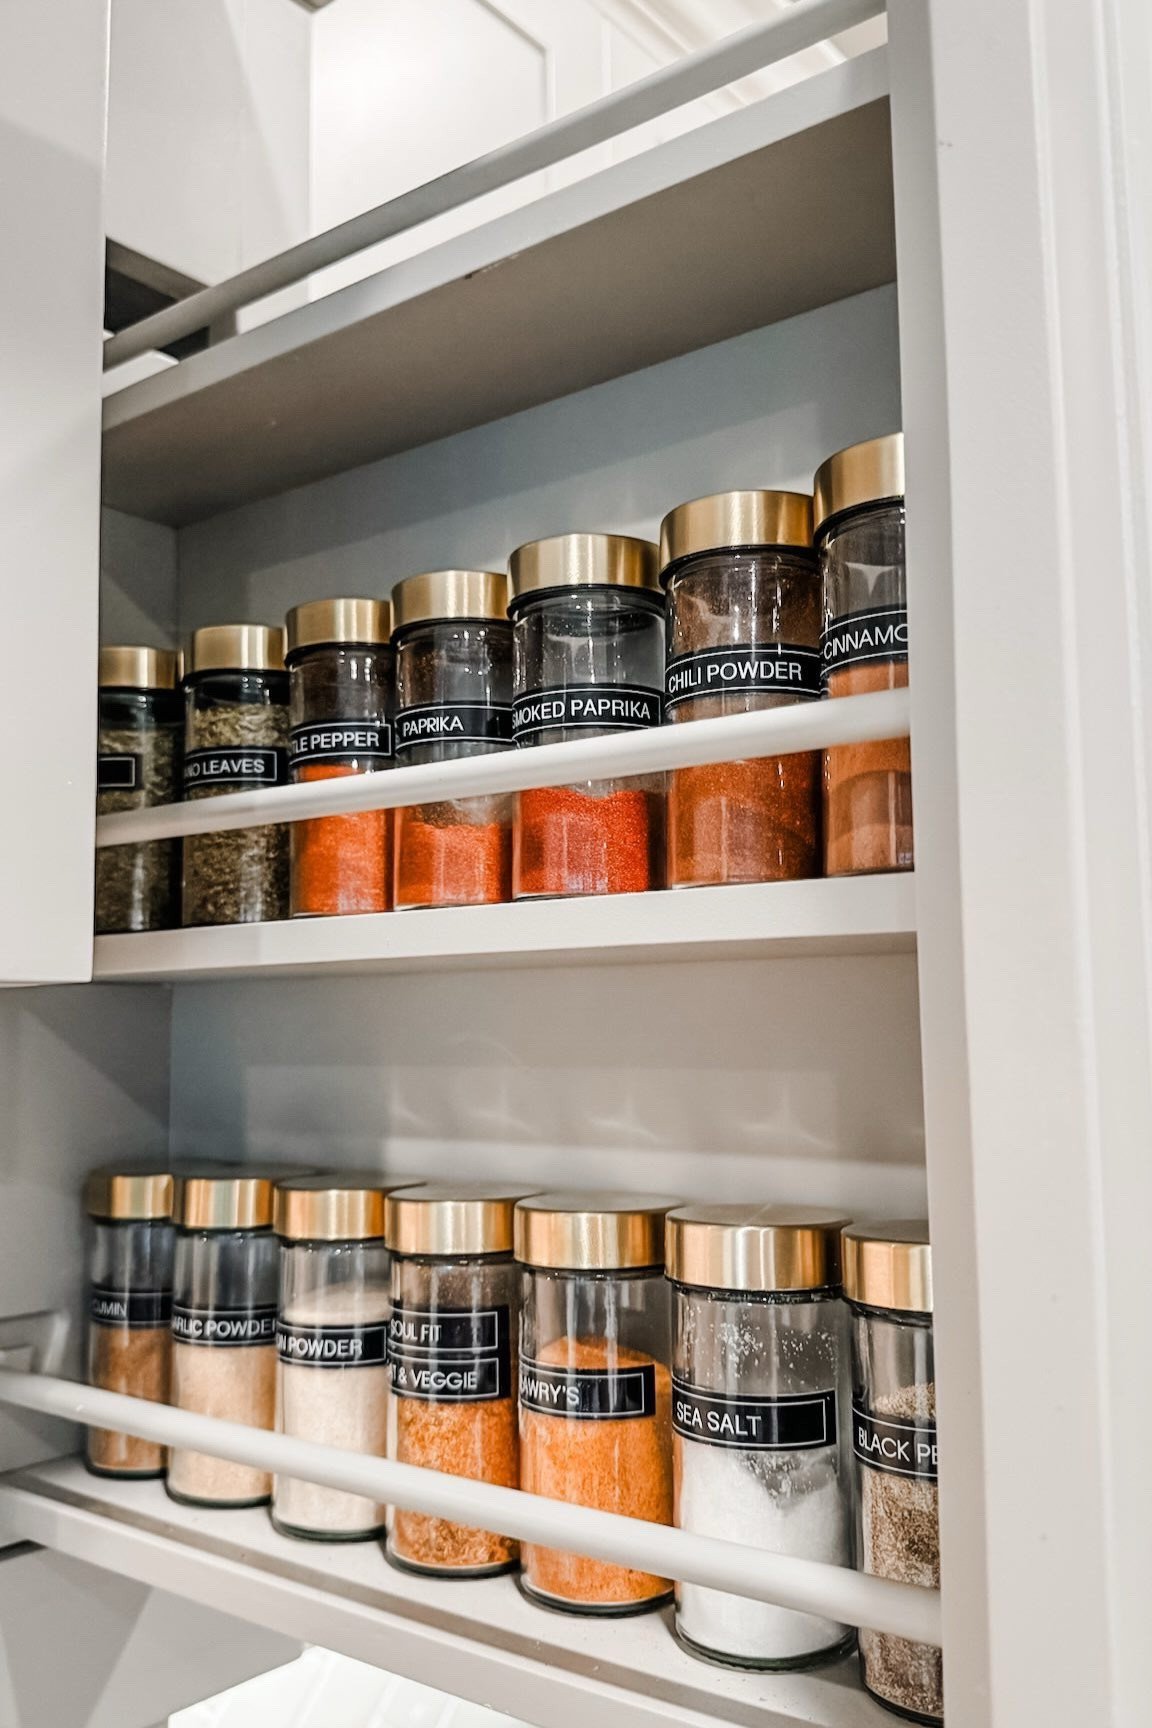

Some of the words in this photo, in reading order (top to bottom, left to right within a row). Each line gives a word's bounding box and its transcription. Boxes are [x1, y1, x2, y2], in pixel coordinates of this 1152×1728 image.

[668, 666, 701, 693] CHILI
[706, 661, 802, 683] POWDER
[403, 715, 464, 737] PAPRIKA
[511, 700, 565, 729] SMOKED
[570, 699, 651, 719] PAPRIKA
[310, 731, 379, 749] PEPPER
[203, 759, 265, 775] LEAVES
[204, 1319, 275, 1338] POWDE
[391, 1318, 418, 1341] SOUL
[420, 1324, 442, 1343] FIT
[288, 1336, 363, 1358] POWDER
[398, 1367, 408, 1384] &
[411, 1370, 478, 1391] VEGGIE
[676, 1401, 703, 1429] SEA
[706, 1411, 762, 1437] SALT
[858, 1426, 911, 1462] BLACK
